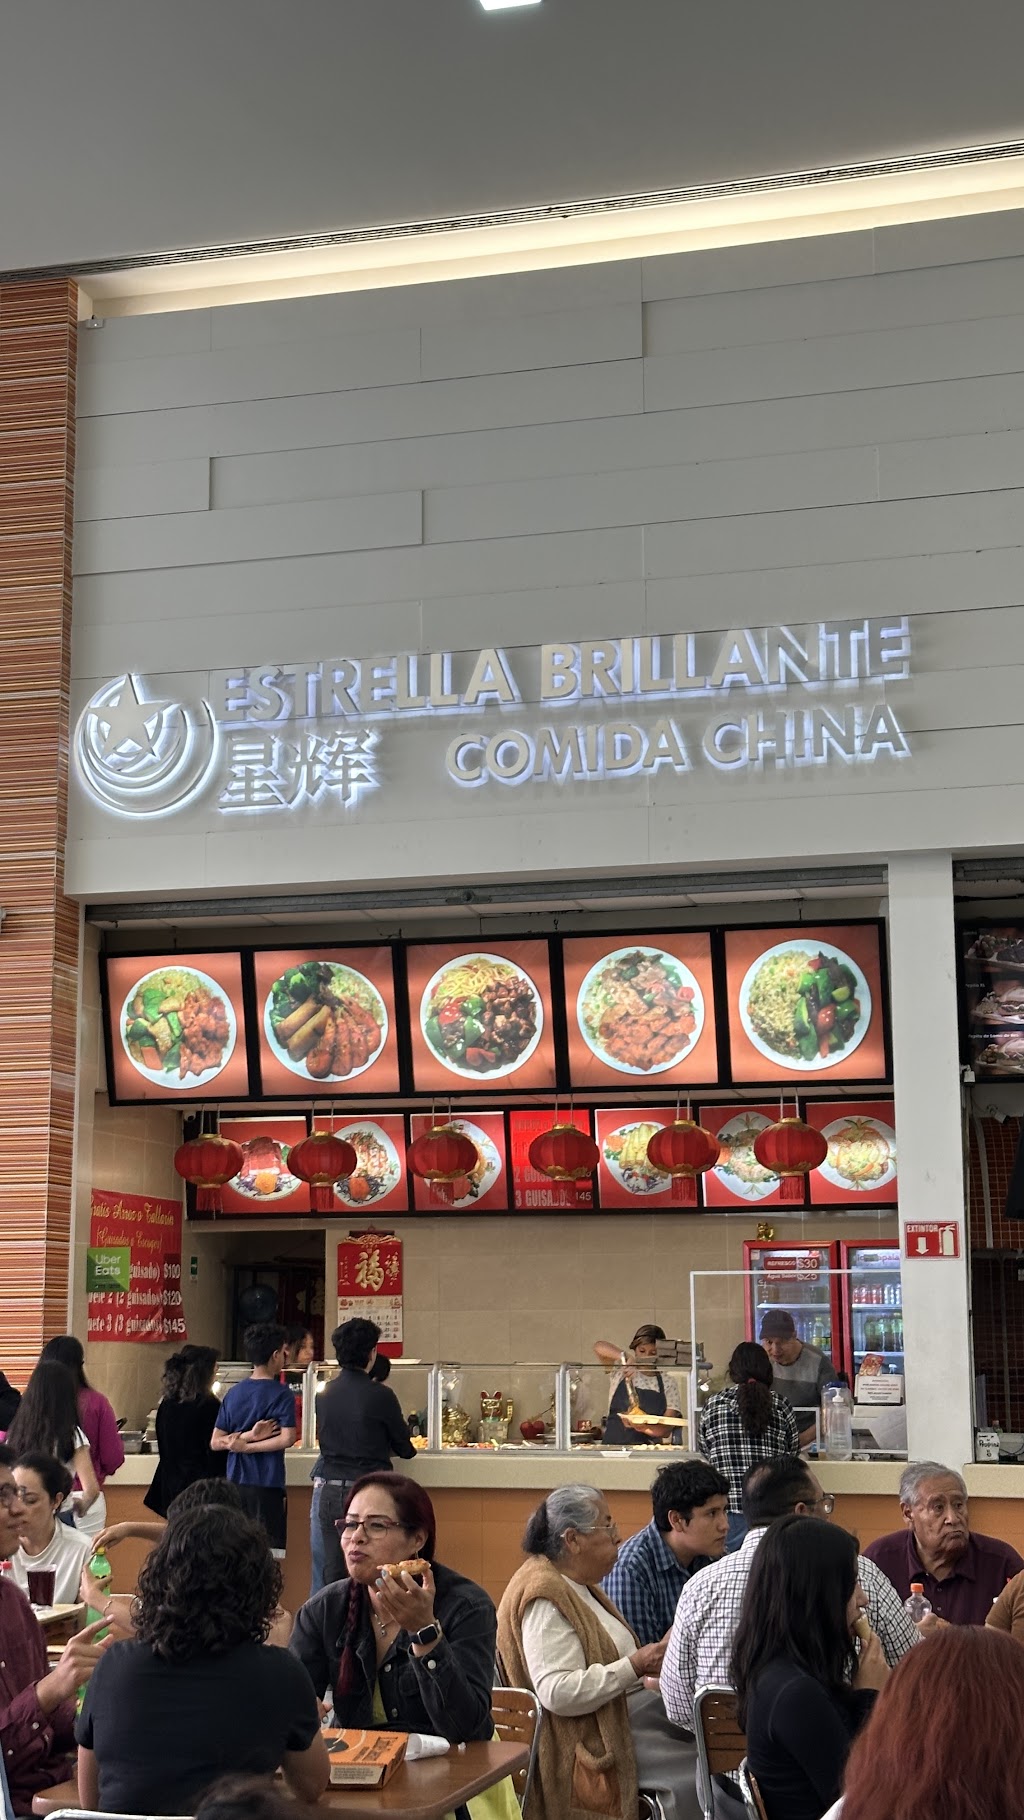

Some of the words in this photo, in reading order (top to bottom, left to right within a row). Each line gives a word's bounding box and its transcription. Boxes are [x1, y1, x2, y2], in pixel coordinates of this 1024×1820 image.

[215, 648, 520, 722] ESTRELLA
[541, 615, 909, 701] BRILLANTE
[446, 719, 690, 785] COMIDA
[703, 703, 909, 768] CHINA
[218, 729, 379, 813] 星辉
[515, 1190, 522, 1207] 3
[575, 1191, 592, 1201] 145
[907, 1224, 938, 1232] EXTINTOR
[95, 1254, 122, 1265] Uber
[797, 1258, 818, 1269] $30
[95, 1266, 120, 1276] Eats
[163, 1263, 181, 1279] $100
[354, 1248, 385, 1292] 福
[163, 1290, 182, 1306] $120
[107, 1313, 112, 1331] 3
[163, 1318, 186, 1335] $145
